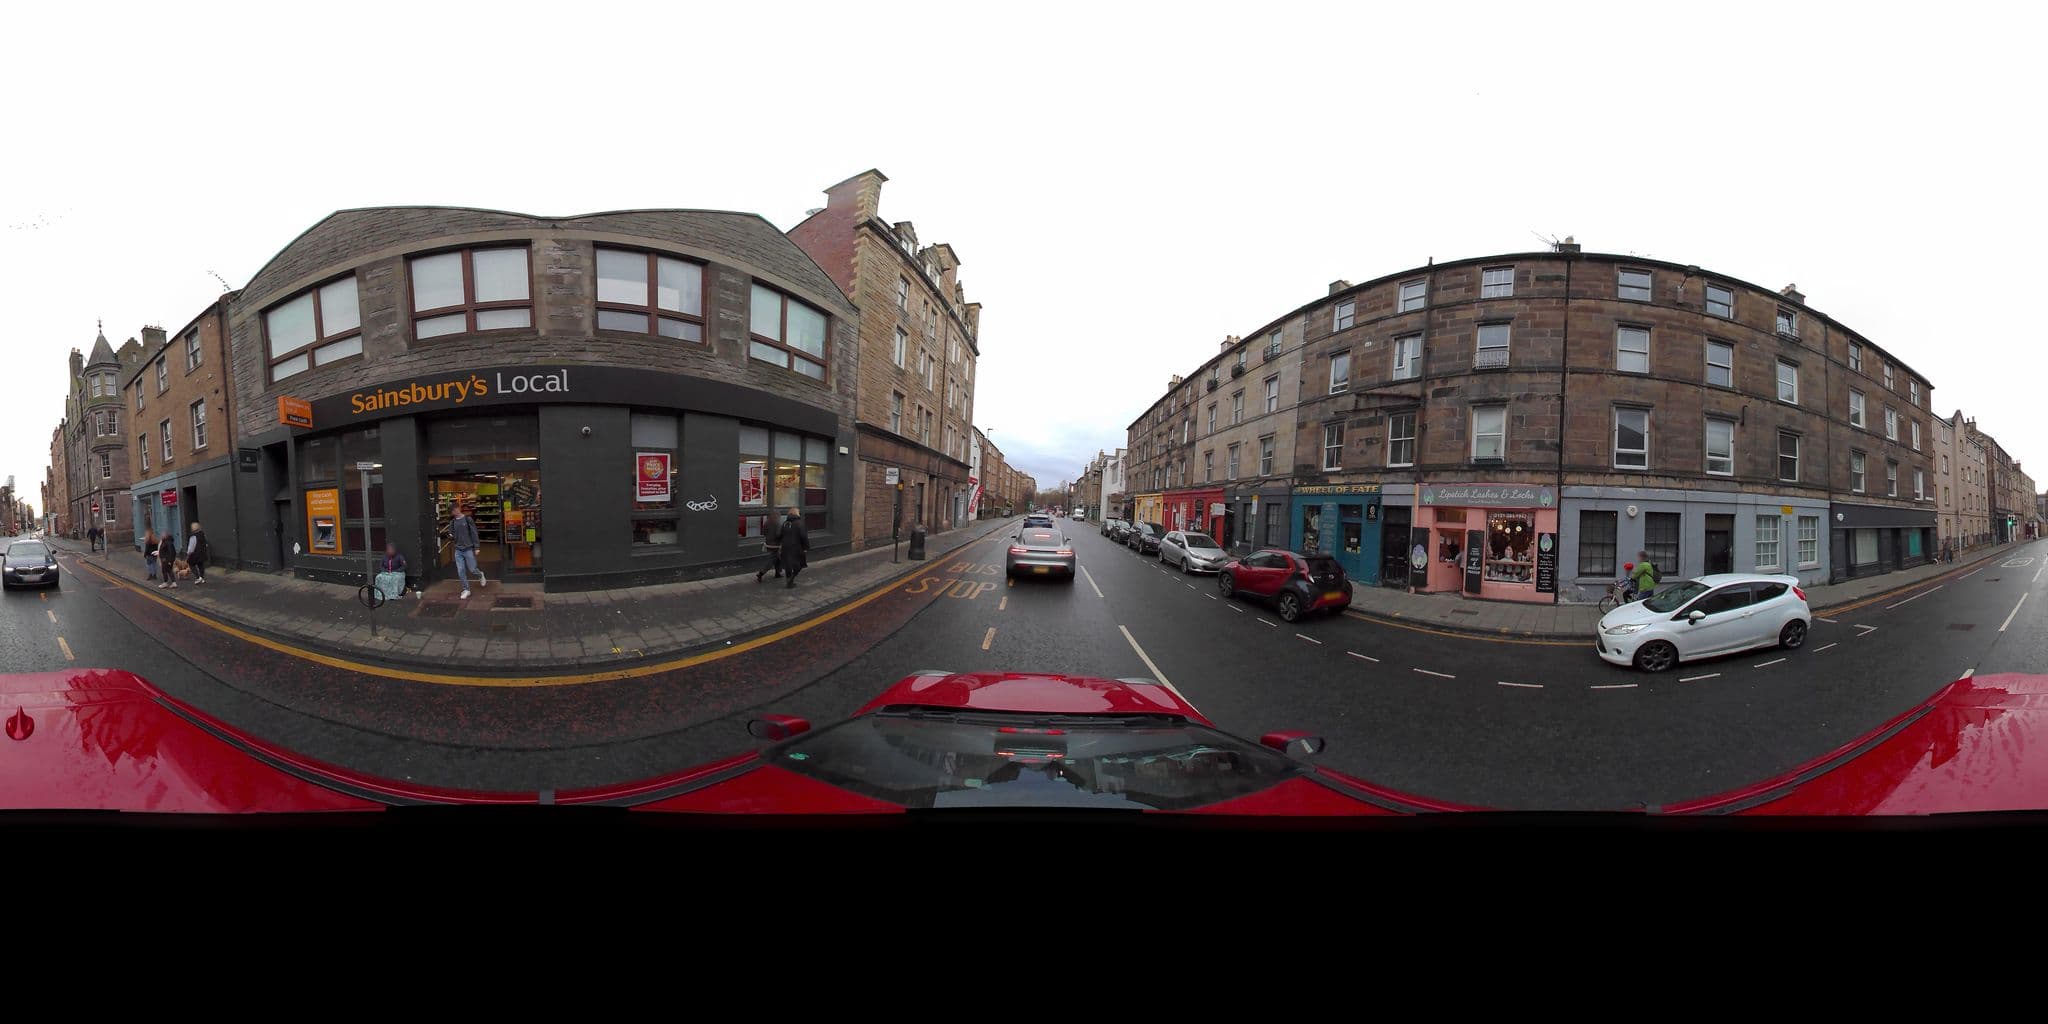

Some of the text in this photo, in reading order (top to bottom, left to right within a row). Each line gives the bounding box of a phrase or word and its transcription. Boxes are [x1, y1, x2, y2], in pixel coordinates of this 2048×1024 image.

[351, 369, 569, 414] Sainsbury's Local
[1336, 486, 1349, 494] OF
[1352, 485, 1378, 493] FATE
[1438, 488, 1535, 500] Lipstick Lashes & Locks
[946, 562, 1001, 575] BUS
[904, 577, 998, 599] STOP
